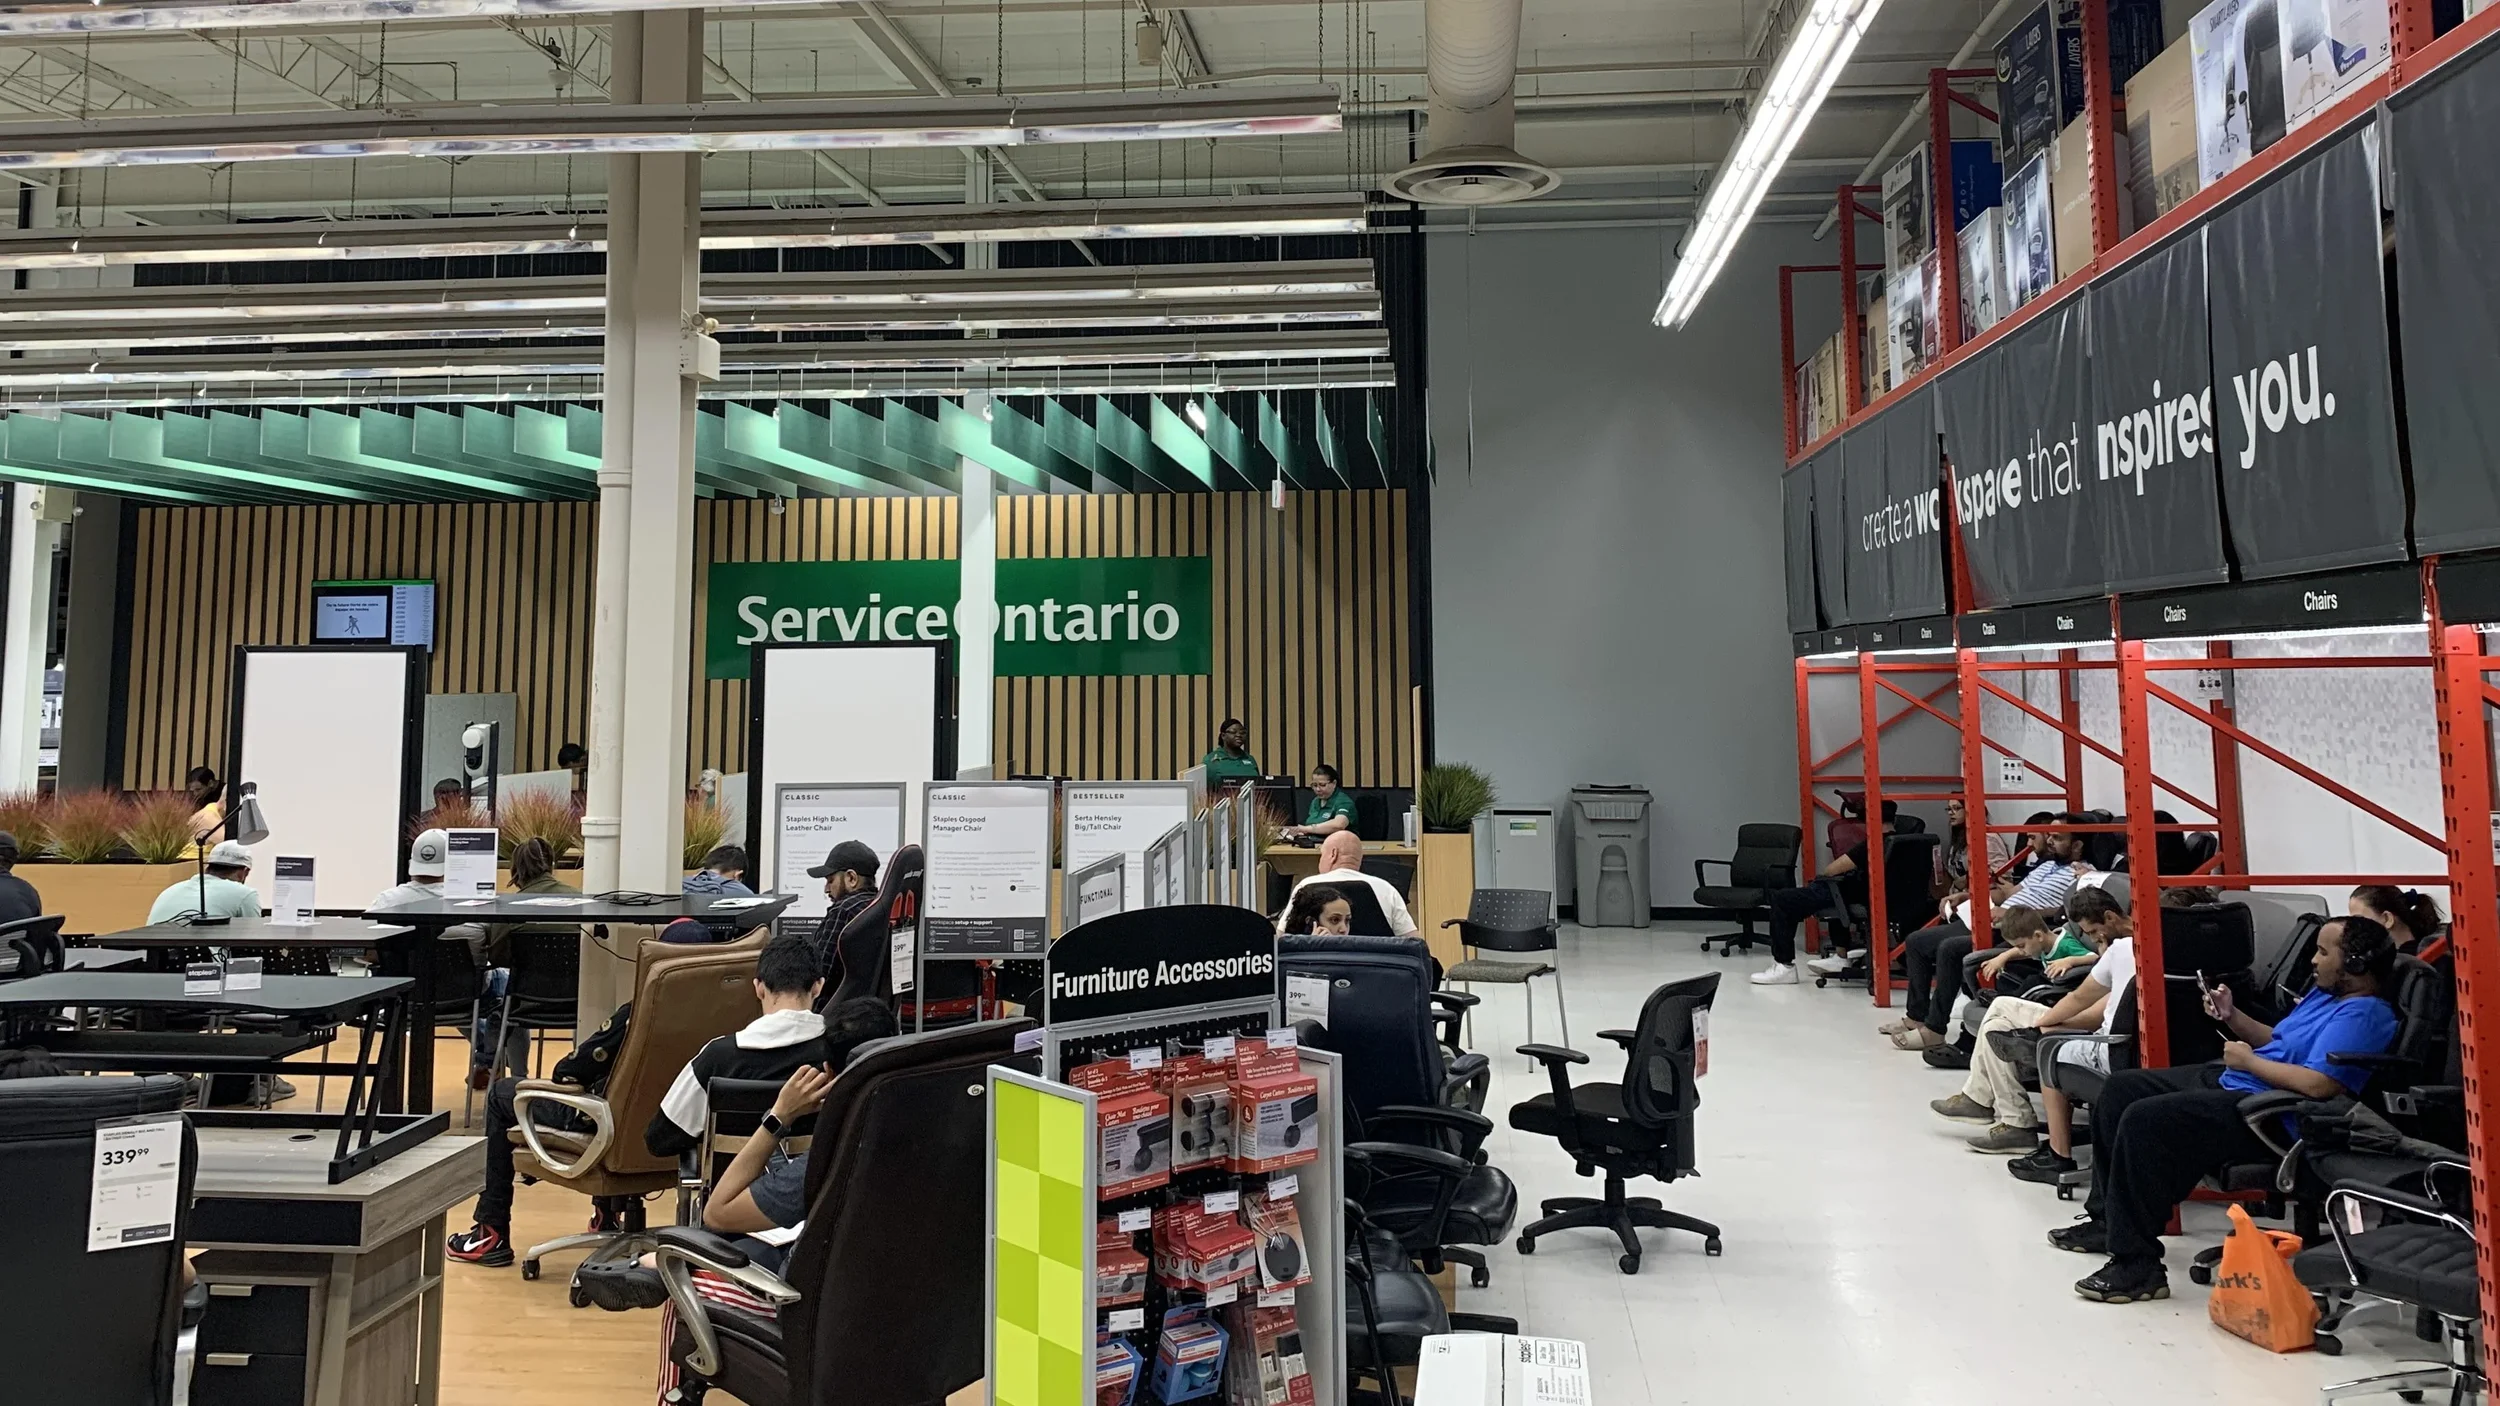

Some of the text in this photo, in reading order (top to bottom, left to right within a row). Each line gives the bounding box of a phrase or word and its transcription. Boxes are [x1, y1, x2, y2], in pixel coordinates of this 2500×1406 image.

[1903, 498, 1912, 539] a
[2027, 420, 2082, 502] that
[2232, 345, 2336, 470] you.
[2303, 590, 2338, 612] Chairs
[2164, 605, 2187, 622] Chairs
[1982, 622, 1996, 636] Chairs
[2056, 615, 2075, 631] Chairs
[786, 815, 812, 823] Staples
[813, 815, 829, 823] High
[933, 815, 986, 824] Staples Osgood
[1094, 814, 1122, 823] Hensley
[963, 824, 982, 832] Chair
[1074, 823, 1101, 831] Big/Tall
[1080, 887, 1113, 905] FUNCTIONAL
[1052, 950, 1273, 999] Furniture Accessories
